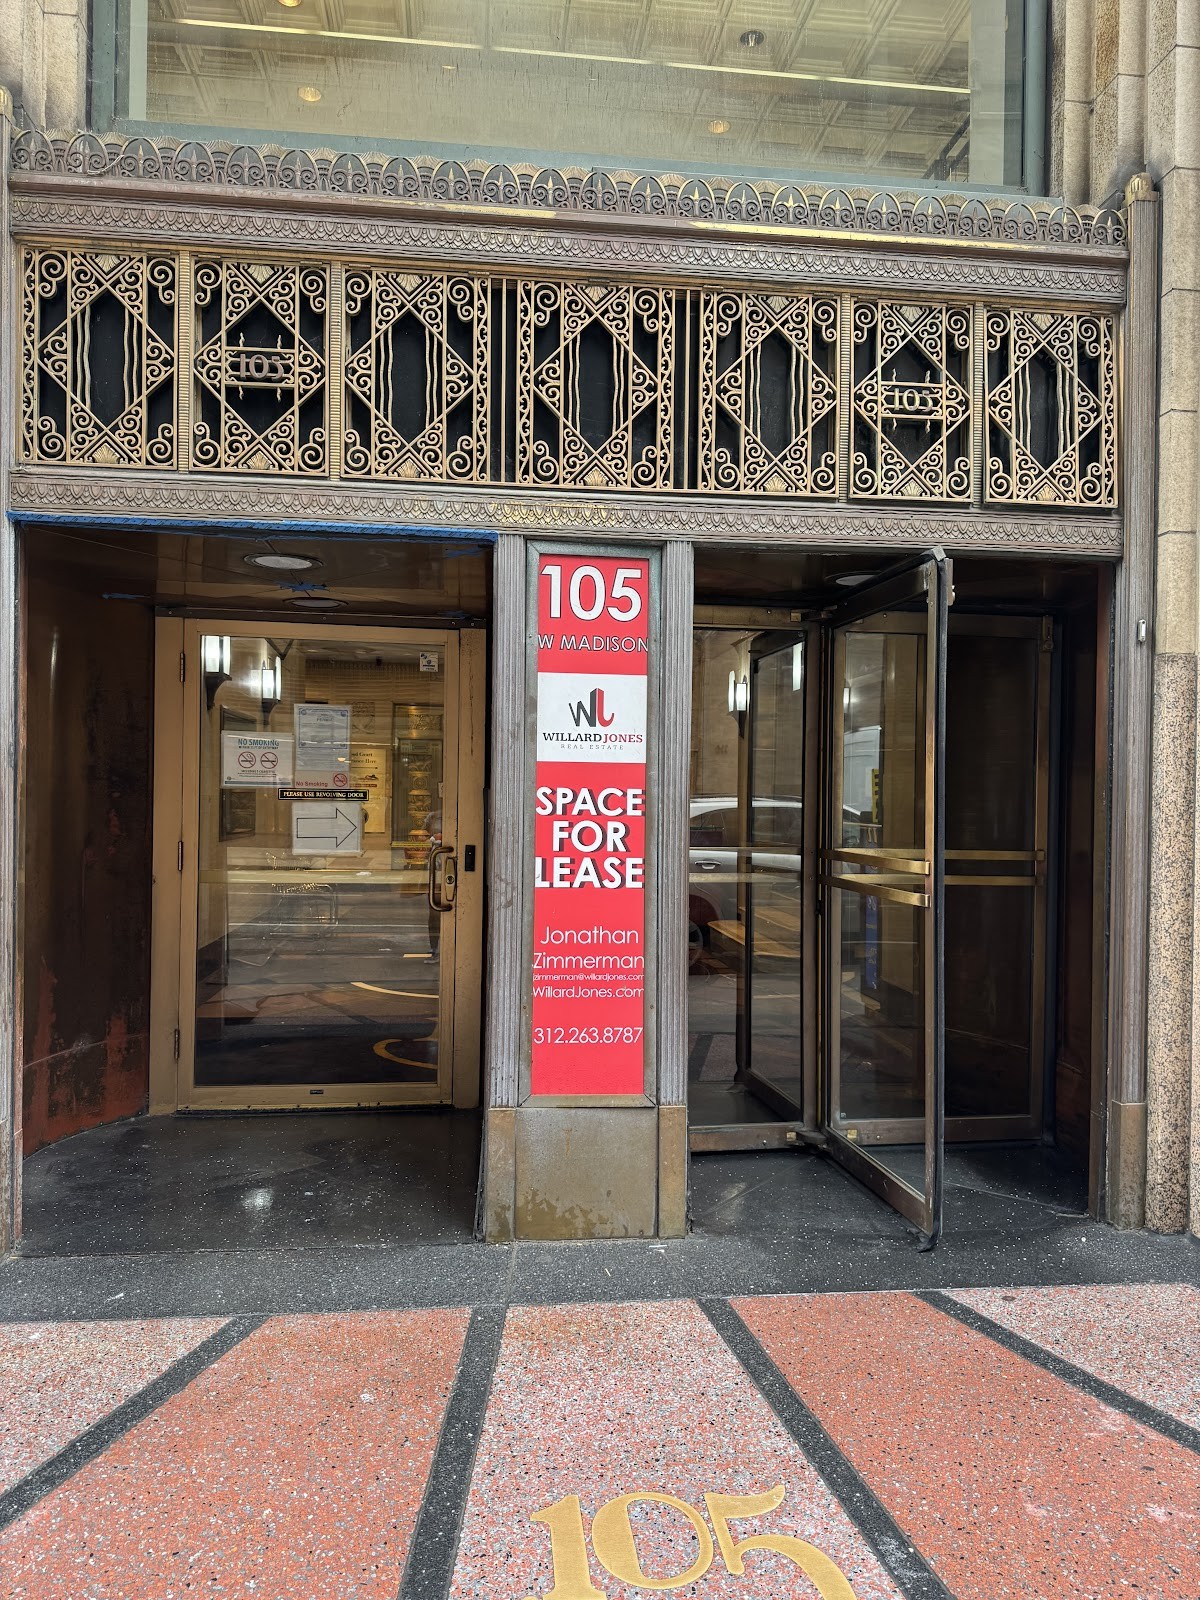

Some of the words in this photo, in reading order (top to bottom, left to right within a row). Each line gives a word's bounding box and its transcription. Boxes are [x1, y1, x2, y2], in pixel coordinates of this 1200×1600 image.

[240, 353, 284, 380] 105
[893, 387, 933, 412] 105
[541, 565, 642, 622] 105
[538, 634, 554, 649] W
[560, 634, 648, 652] MADISON
[248, 739, 279, 747] SMOKING
[535, 786, 645, 817] SPACE
[552, 820, 631, 853] FOR
[534, 856, 645, 889] LEASE
[540, 926, 639, 944] Jonathan
[533, 952, 645, 969] Zimmerman
[533, 1027, 643, 1044] 312.263.8787
[530, 1485, 857, 1600] 105
